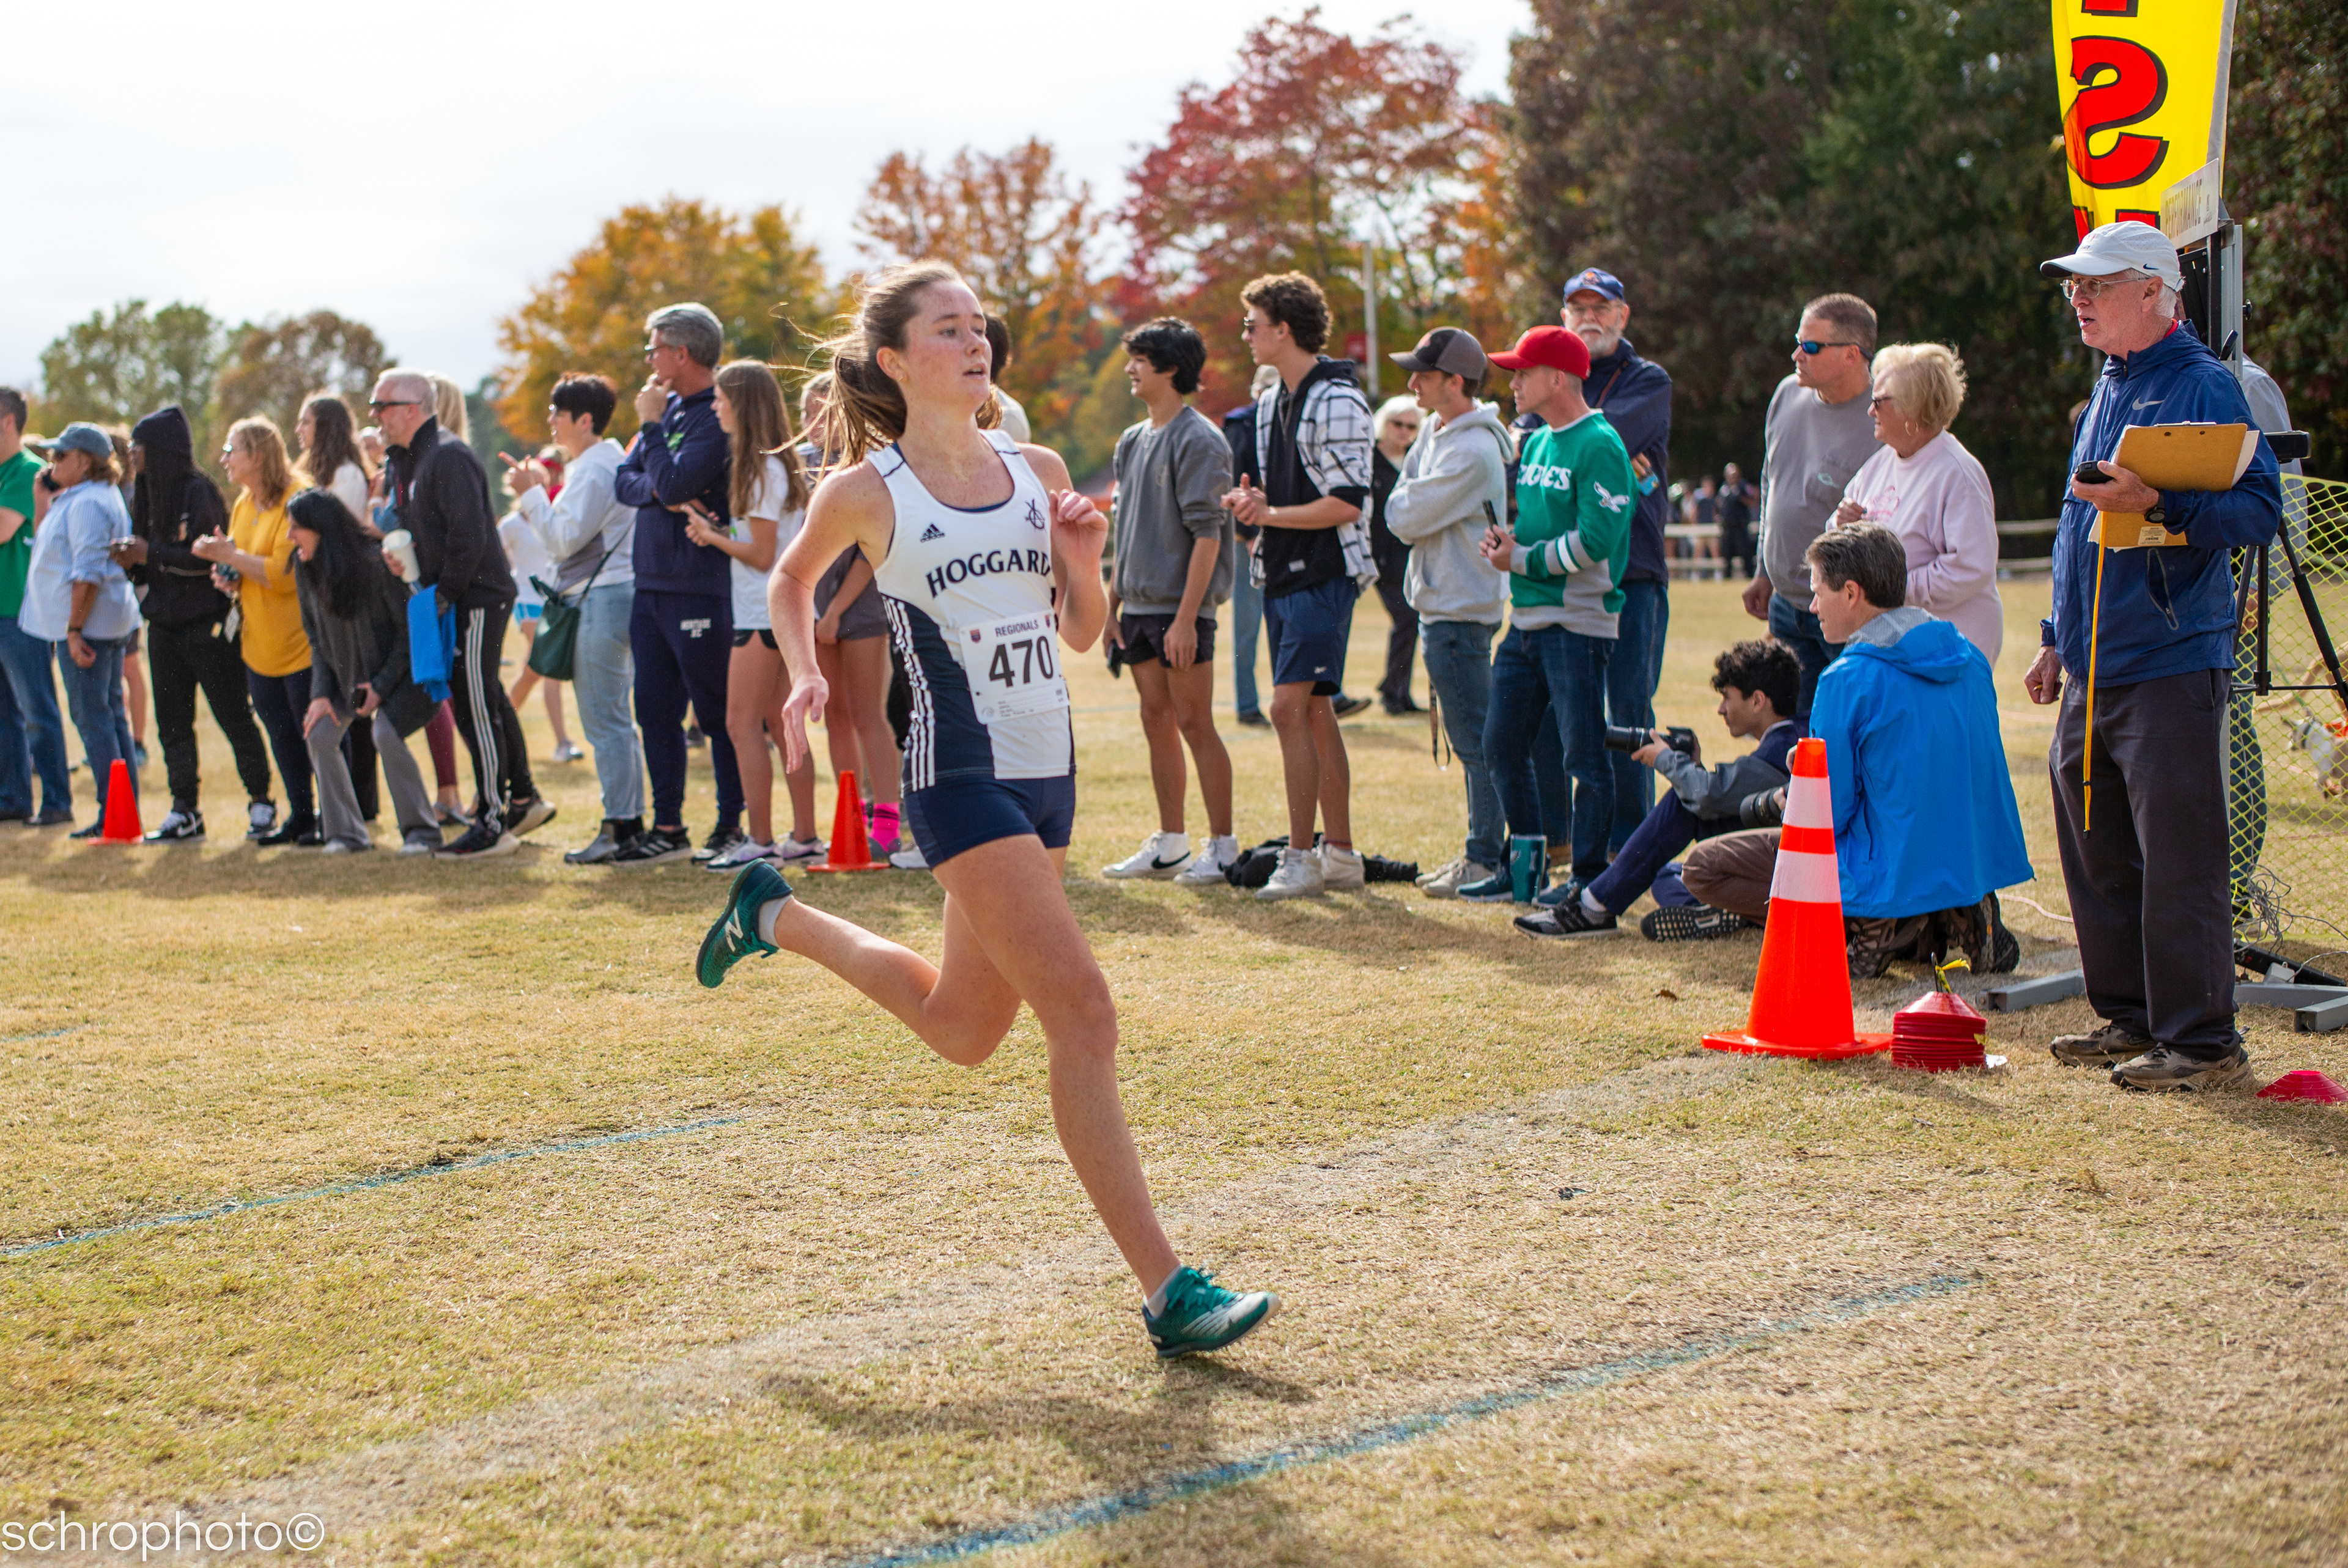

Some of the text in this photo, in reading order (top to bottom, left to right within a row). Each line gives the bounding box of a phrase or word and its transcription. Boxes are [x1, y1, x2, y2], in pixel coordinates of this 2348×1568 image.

[926, 548, 1051, 600] HOGGARD
[995, 620, 1039, 637] REGIONALS
[989, 636, 1054, 688] 470
